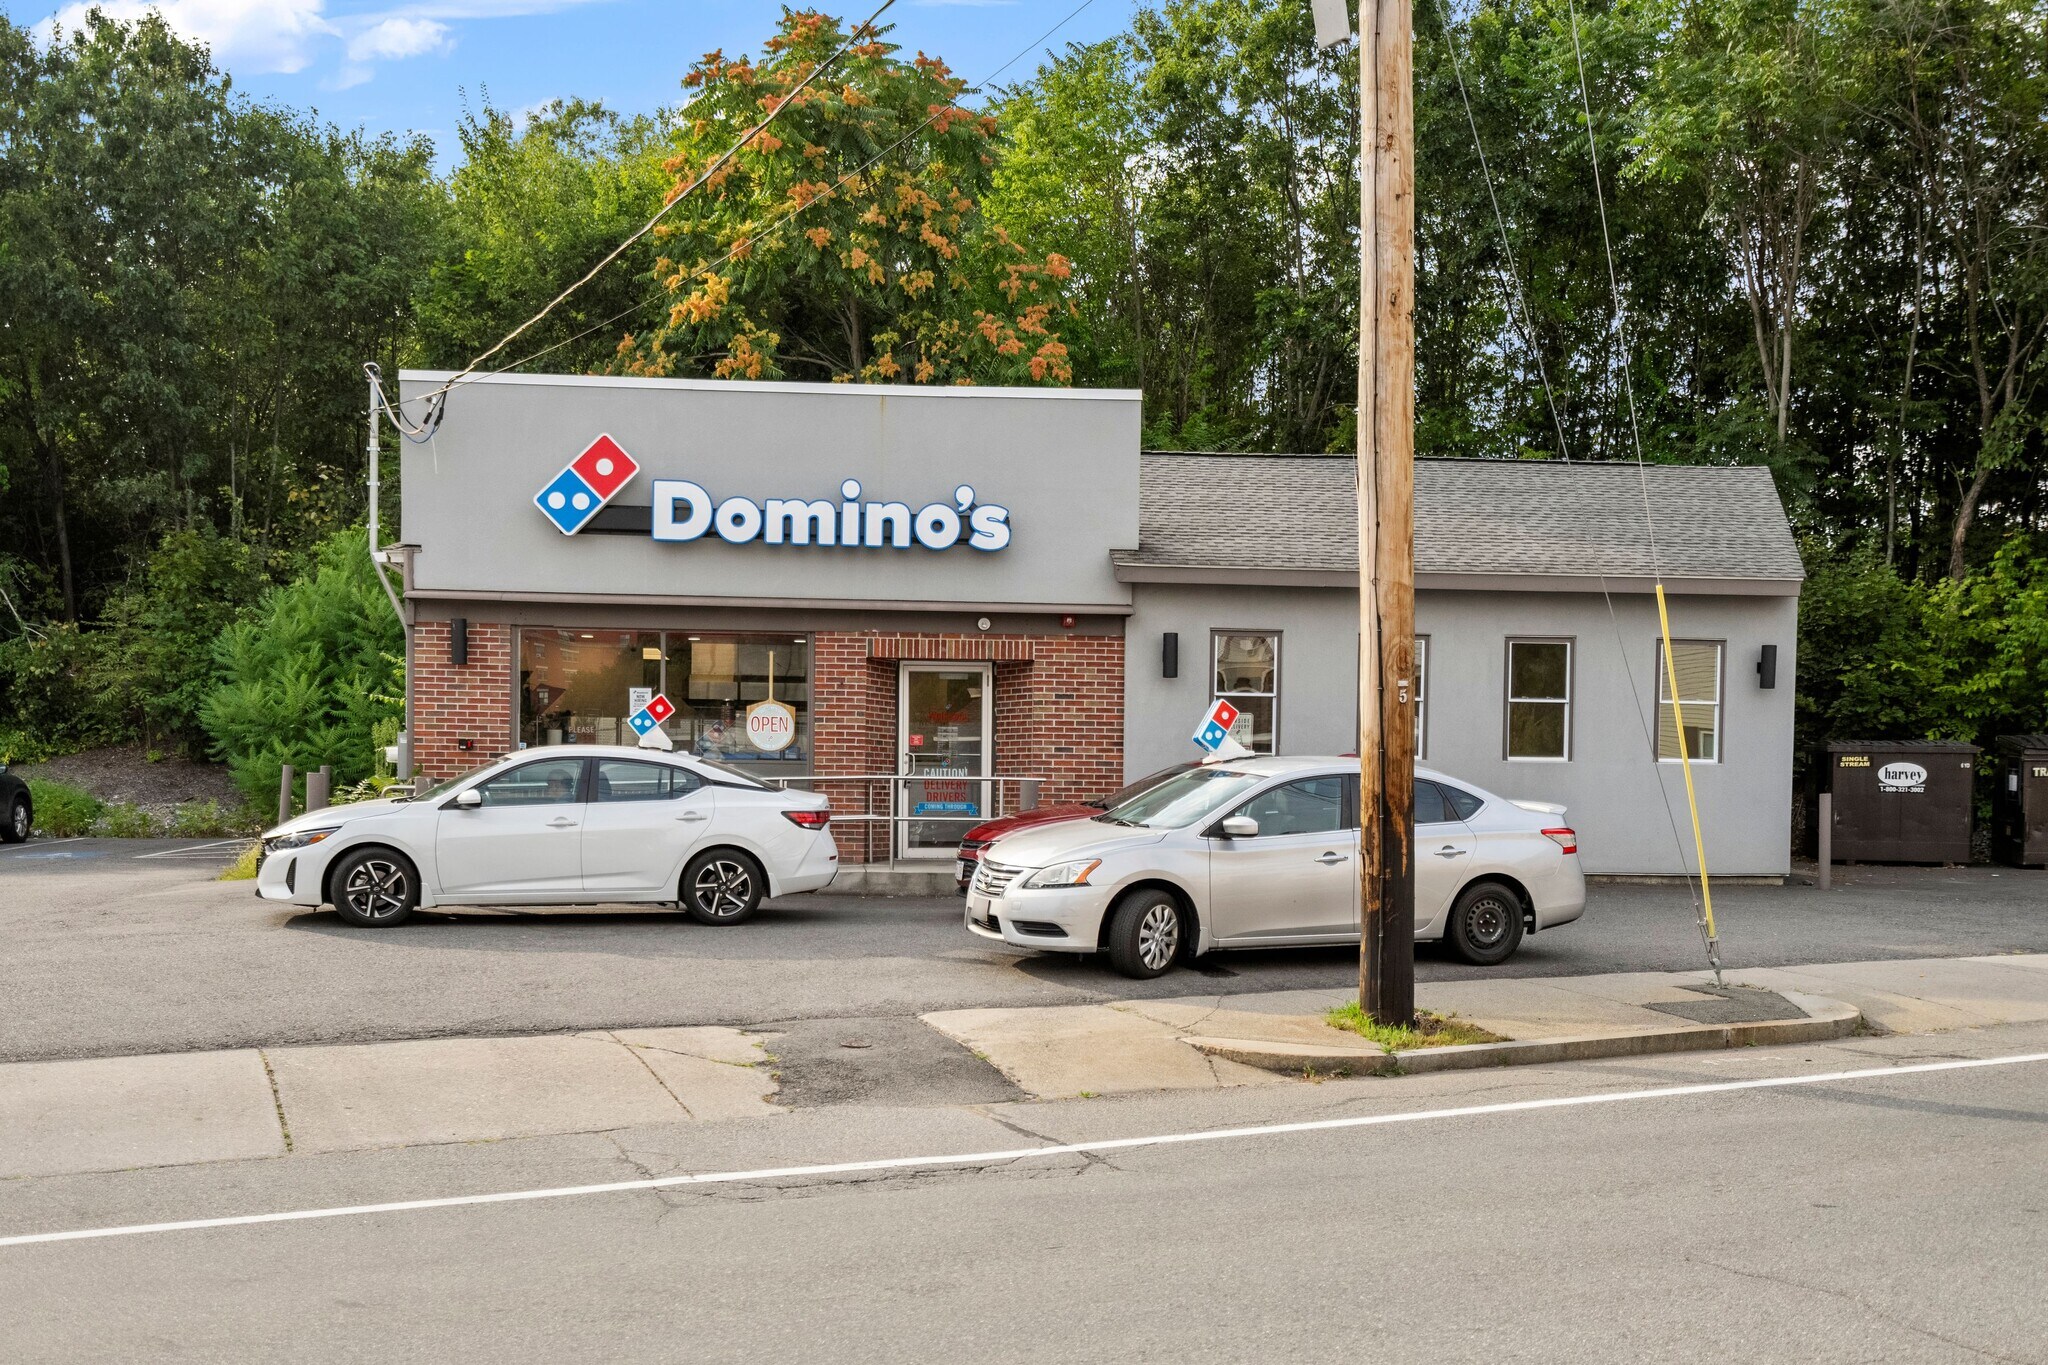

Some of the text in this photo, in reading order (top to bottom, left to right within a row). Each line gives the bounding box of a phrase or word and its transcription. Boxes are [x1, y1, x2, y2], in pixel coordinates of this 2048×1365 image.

[650, 478, 1011, 552] Domino's
[1399, 688, 1408, 704] 5
[568, 726, 595, 734] PLEASE
[751, 715, 789, 732] OPEN
[1884, 767, 1924, 784] harvey
[2032, 767, 2048, 777] TR
[924, 780, 968, 790] DELIVERY
[926, 792, 967, 802] DRIVERS
